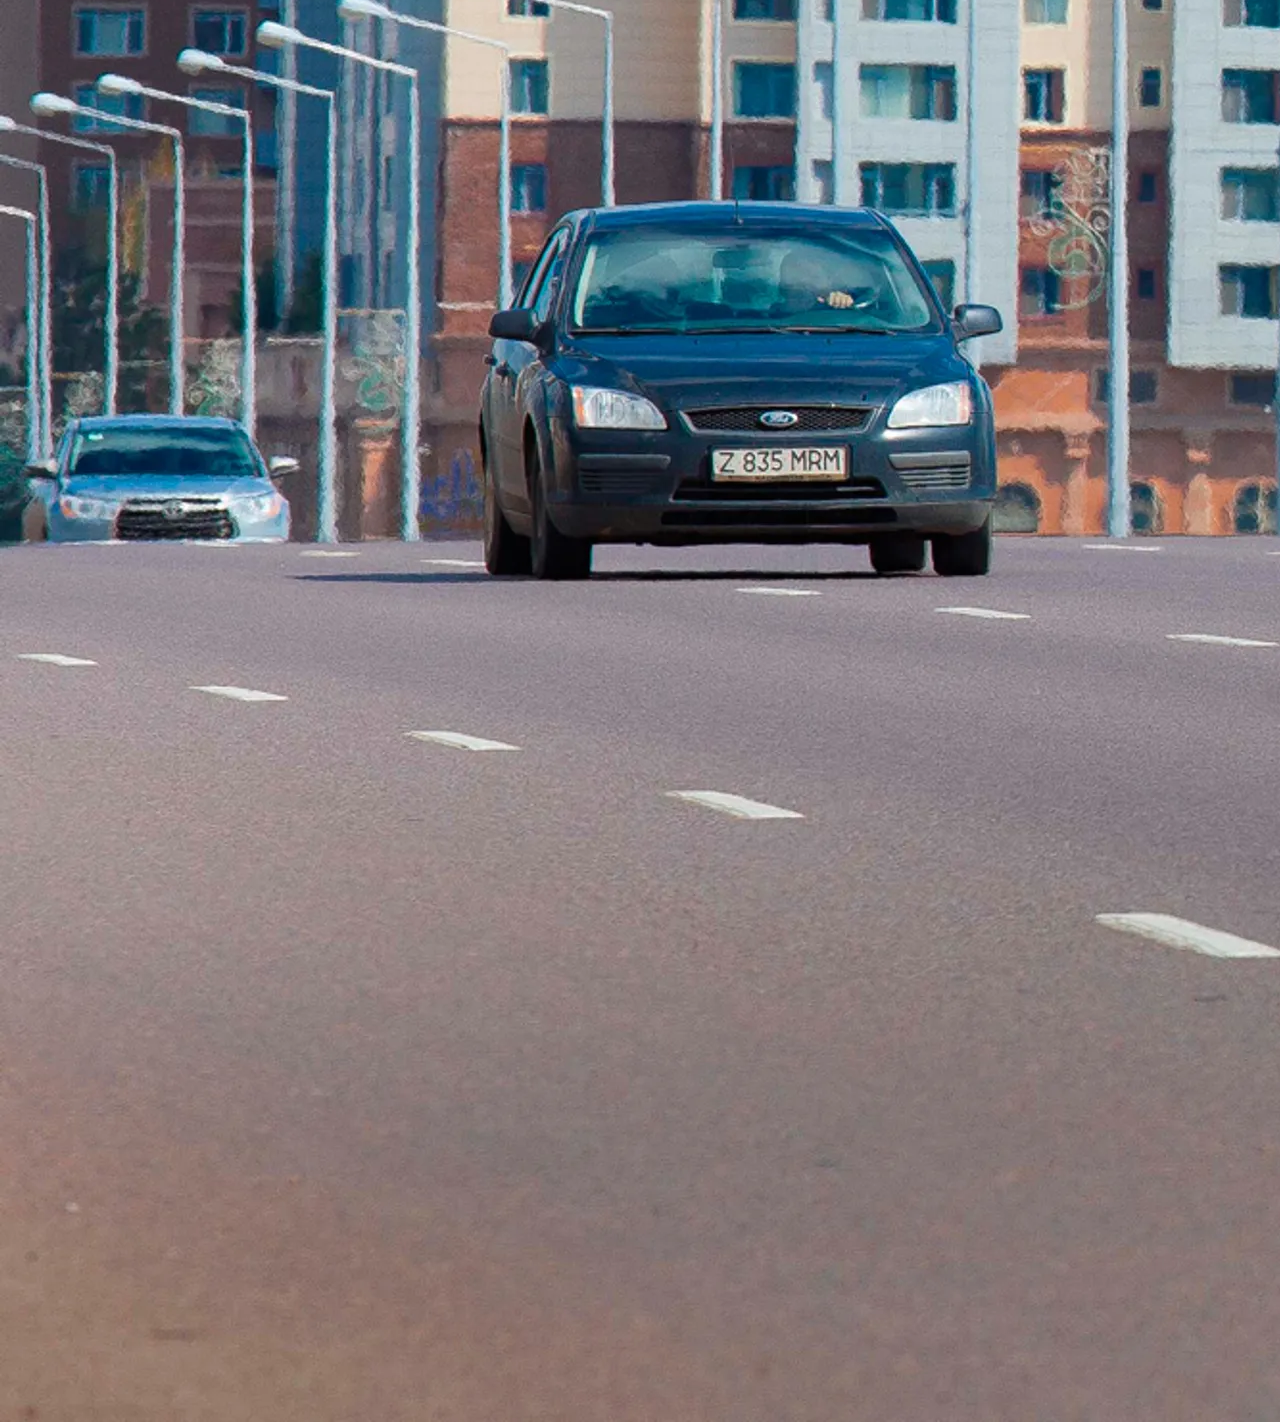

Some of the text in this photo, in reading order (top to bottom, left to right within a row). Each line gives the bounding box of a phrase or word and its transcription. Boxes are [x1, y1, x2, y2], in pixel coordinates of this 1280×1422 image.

[719, 450, 840, 473] Z 835 MRM
